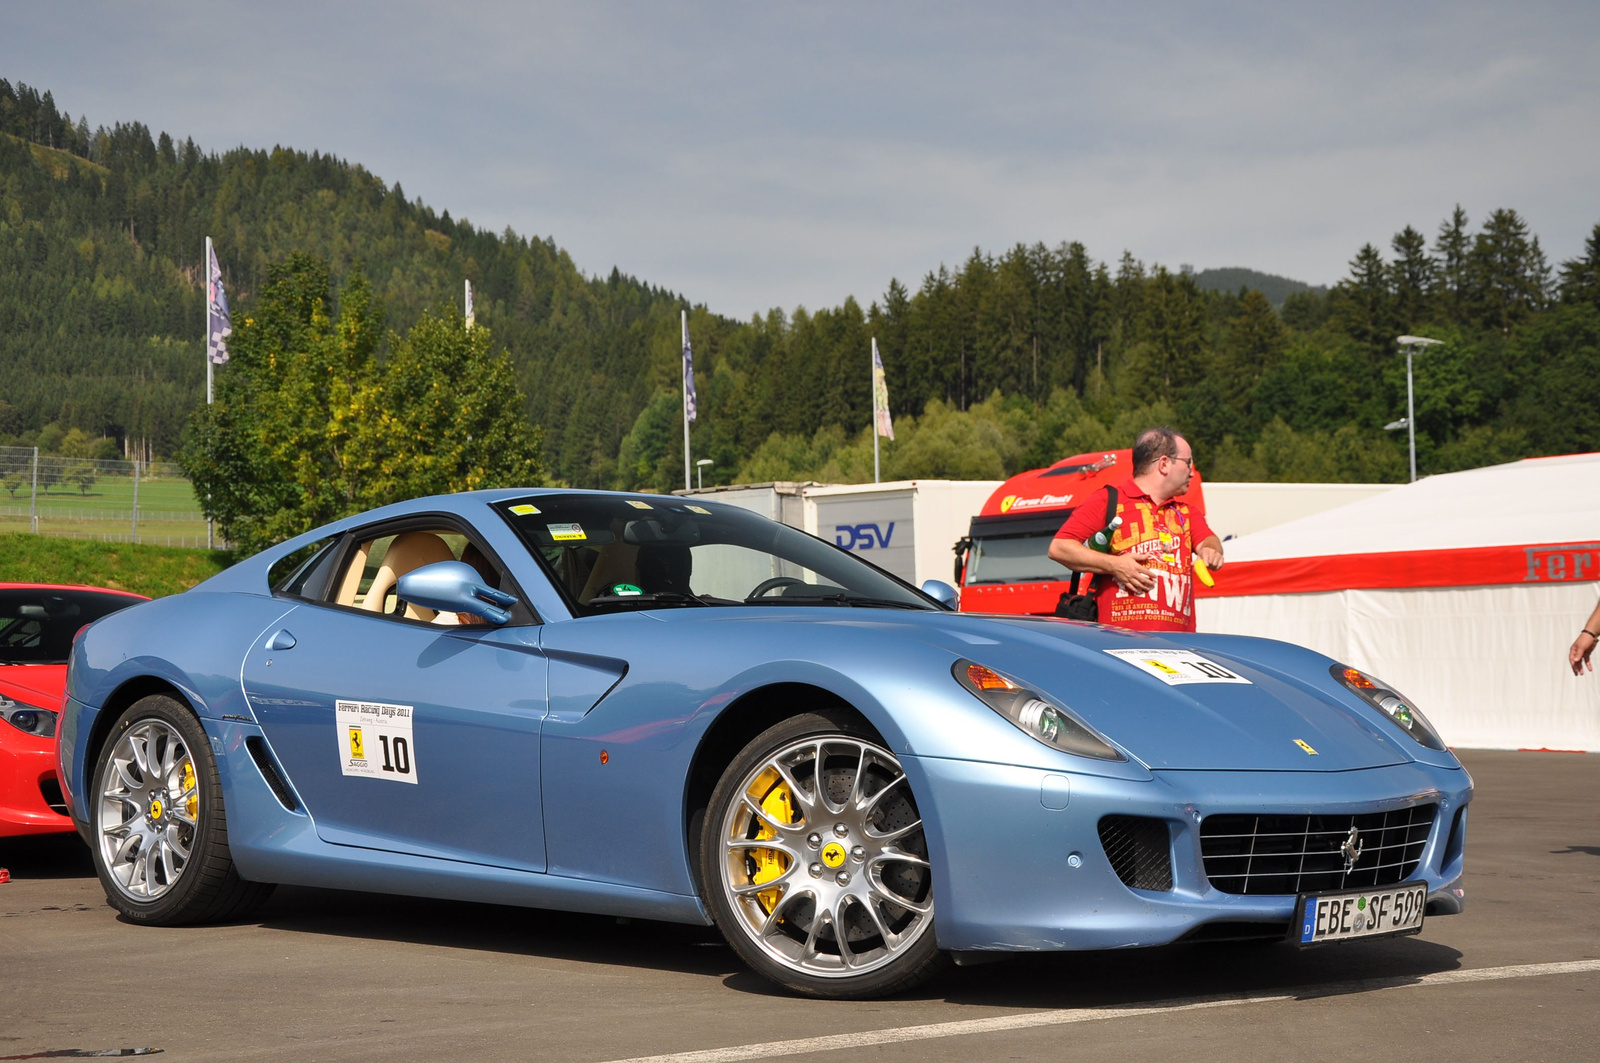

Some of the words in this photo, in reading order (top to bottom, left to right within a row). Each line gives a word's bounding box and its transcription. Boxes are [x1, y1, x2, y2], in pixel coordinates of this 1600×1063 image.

[836, 522, 895, 551] DSV
[1523, 544, 1600, 580] Fer
[1160, 609, 1175, 617] Alone
[1180, 661, 1237, 679] 10
[338, 702, 360, 712] Ferrari
[361, 704, 380, 717] Racing
[381, 706, 397, 718] Days
[397, 708, 410, 717] 2011
[379, 735, 410, 774] 10
[1315, 899, 1354, 936] EBE
[1366, 895, 1391, 930] SF
[1392, 889, 1424, 926] 599
[1304, 924, 1311, 935] D
